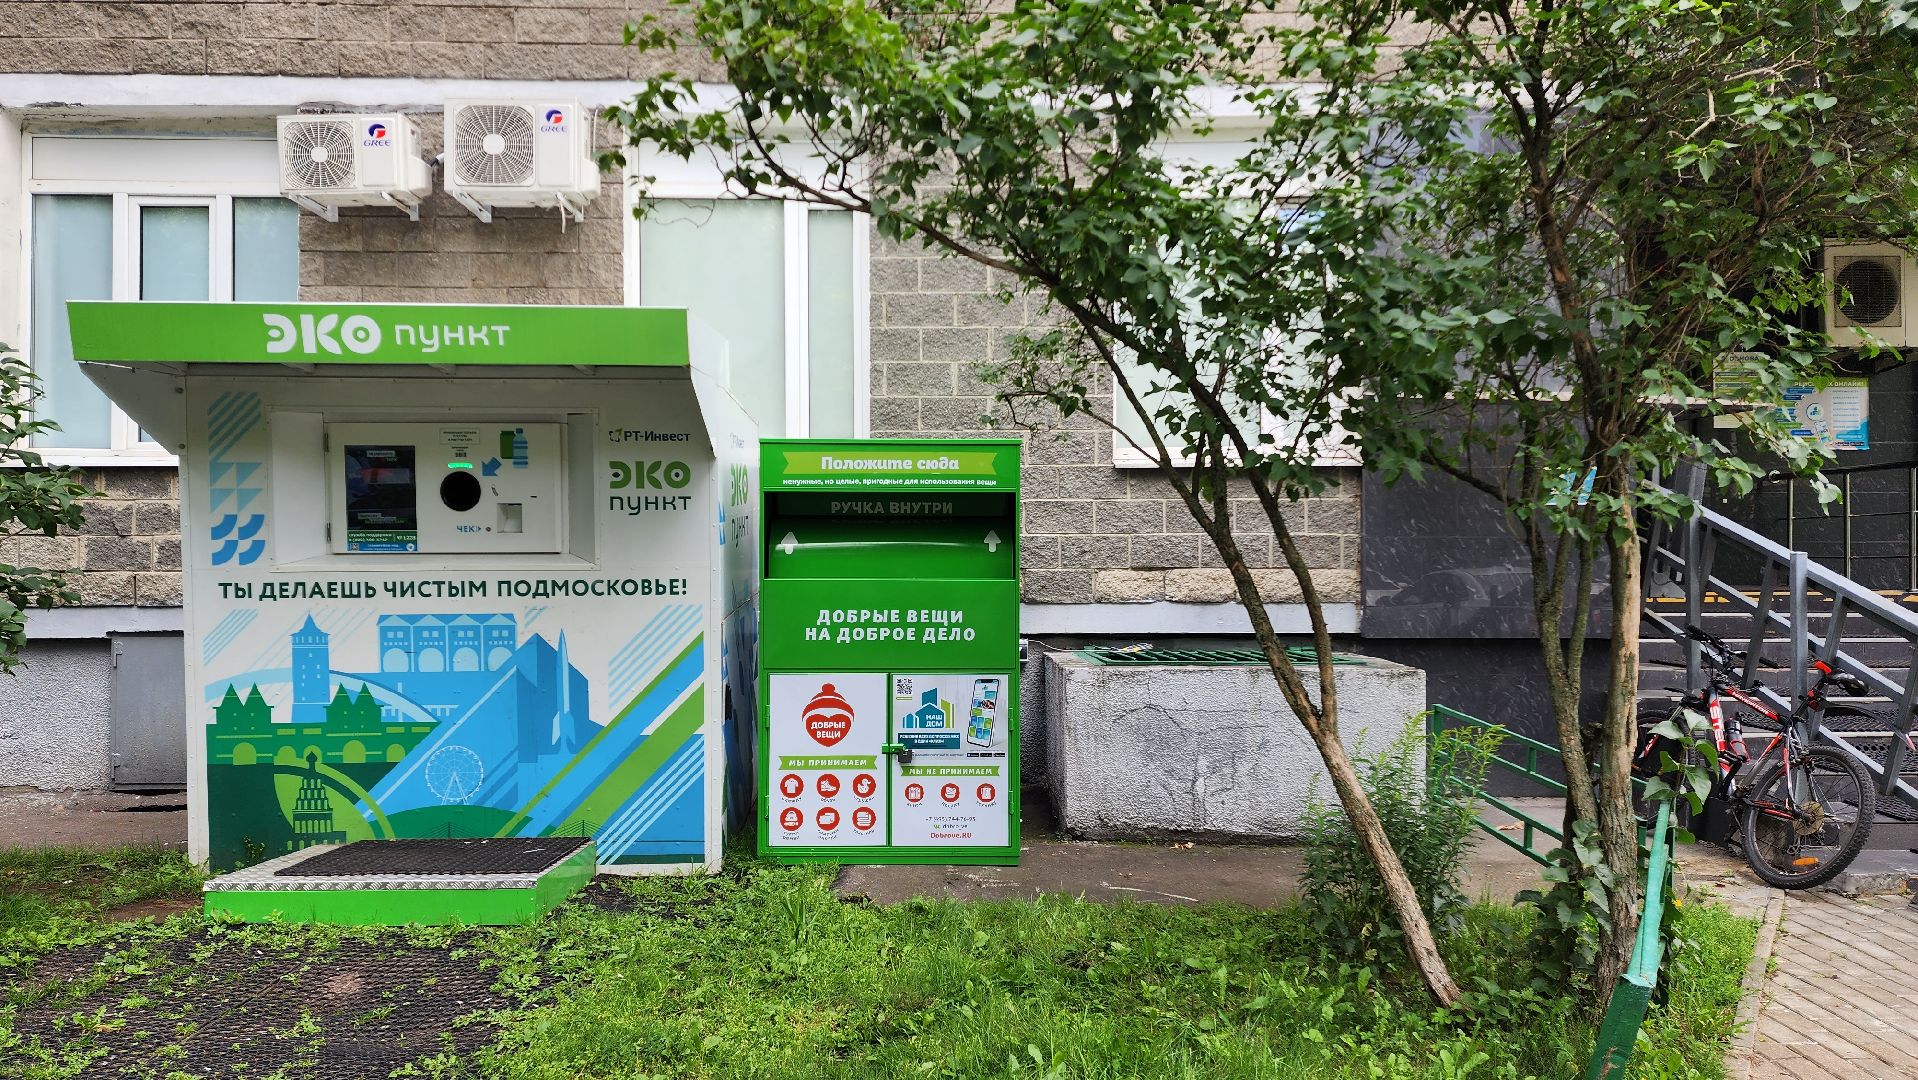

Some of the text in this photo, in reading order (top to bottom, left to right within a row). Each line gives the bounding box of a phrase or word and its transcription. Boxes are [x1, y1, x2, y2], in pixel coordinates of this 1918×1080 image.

[540, 124, 568, 133] GREE
[363, 138, 392, 147] GREE
[263, 313, 381, 355] ЭКО
[624, 430, 691, 442] РТ-Инвест
[821, 456, 959, 470] Положите сюда
[609, 460, 691, 489] ЭКО
[831, 501, 953, 514] РУЧКА ВНУТРИ
[456, 525, 475, 534] ЧЕК
[219, 577, 688, 602] ТЫ ДЕЛАЕШЬ ЧИСТЫМ ПОДМОСКОВЬЕ!
[817, 609, 964, 625] ДОБРЫЕ ВЕЩИ
[805, 627, 976, 643] НА ДОБРОЕ ДЕЛО
[810, 721, 846, 730] ДОБРЫЕ
[816, 731, 841, 739] ВЕЩИ
[808, 759, 868, 767] ПРИНИМАЕМ
